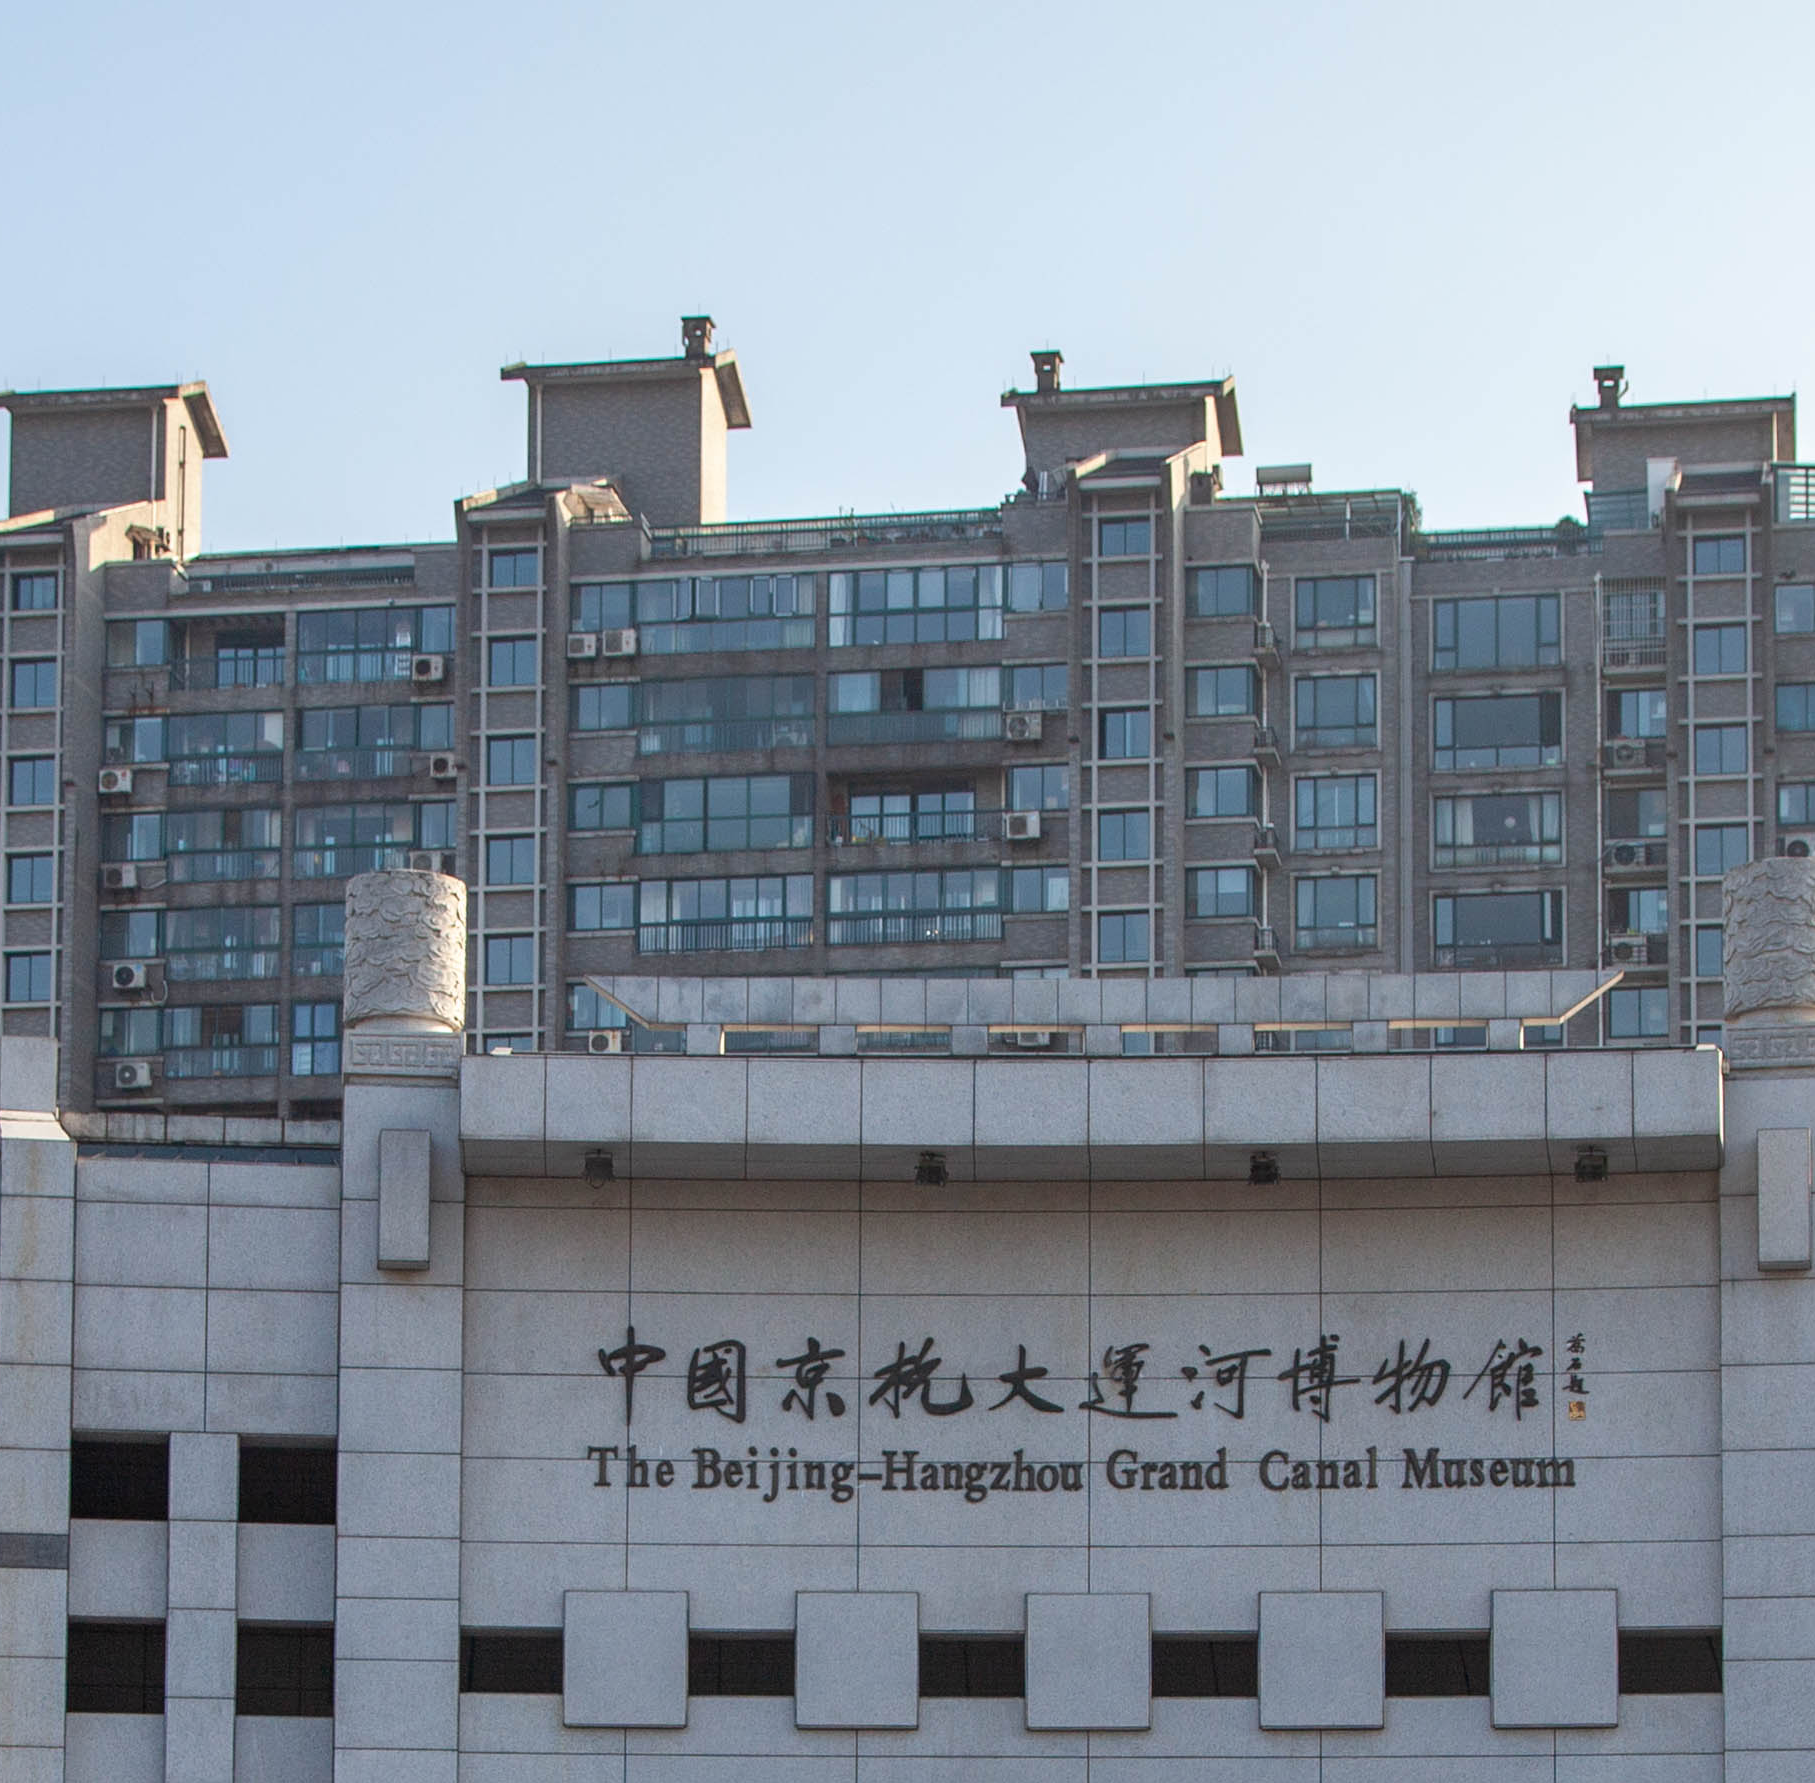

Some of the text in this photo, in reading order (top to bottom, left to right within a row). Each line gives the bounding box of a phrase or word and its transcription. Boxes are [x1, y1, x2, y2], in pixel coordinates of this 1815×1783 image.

[587, 1446, 1576, 1502] The Beijing-Hangzhou Grand Canal Museum
